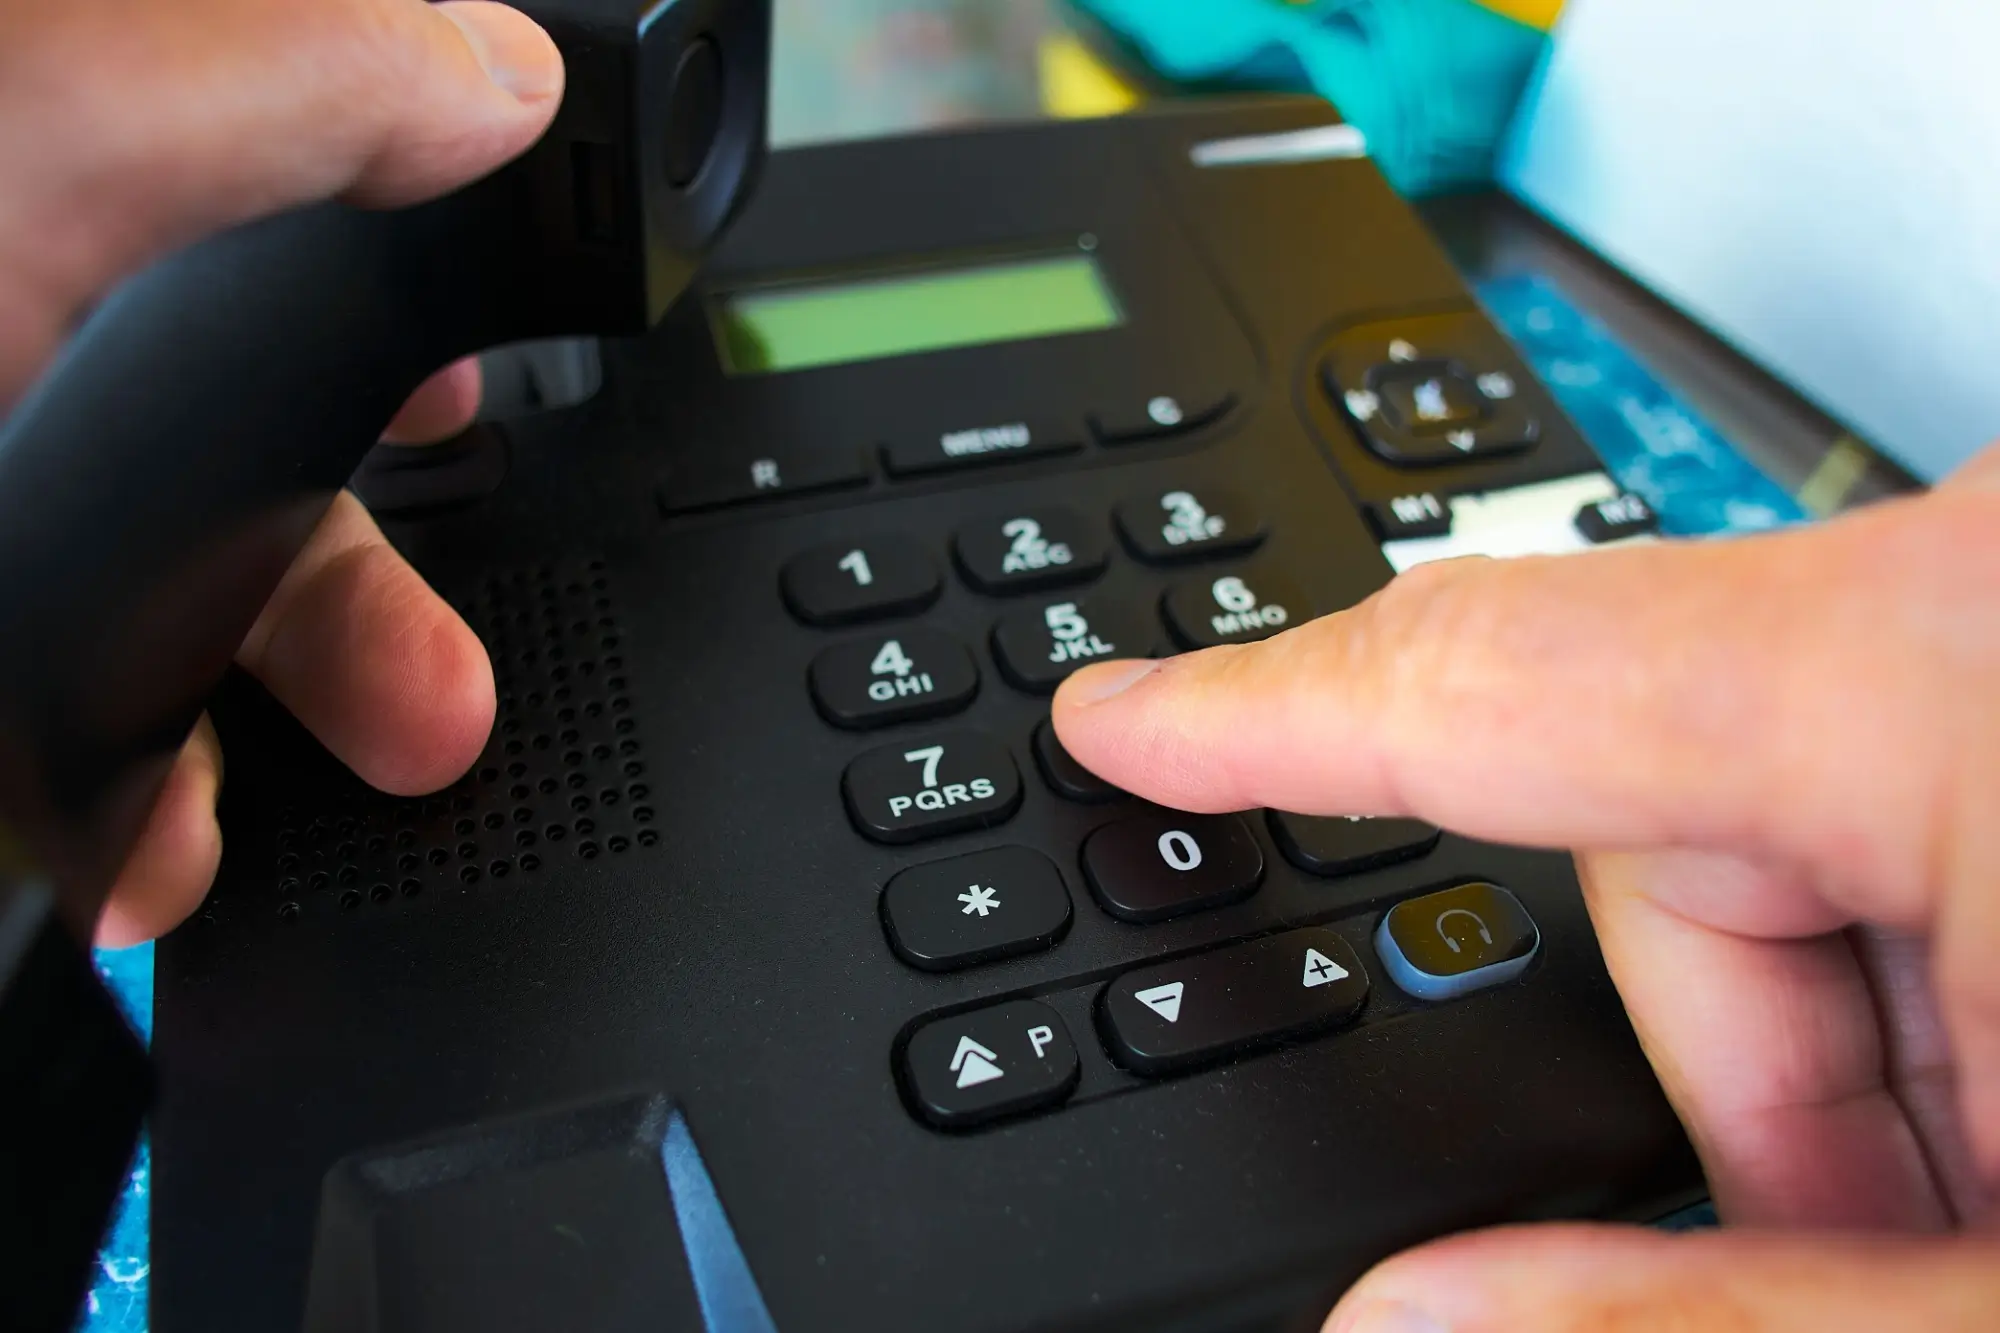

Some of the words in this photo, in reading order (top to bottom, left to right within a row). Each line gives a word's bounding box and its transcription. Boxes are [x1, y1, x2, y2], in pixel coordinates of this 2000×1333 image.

[941, 423, 1030, 456] MENU
[751, 459, 780, 488] R
[1161, 491, 1203, 526] 3
[1003, 518, 1043, 555] 2
[838, 549, 873, 585] 1
[1003, 541, 1074, 573] ABC
[1211, 576, 1257, 612] 6
[1044, 602, 1089, 641] 5
[1211, 604, 1288, 635] MNO
[870, 640, 914, 679] 4
[1048, 634, 1115, 663] JKL
[867, 672, 935, 702] GHI
[902, 745, 945, 788] 7
[887, 776, 996, 818] PQRS
[1156, 829, 1203, 873] 0
[1026, 1024, 1054, 1059] P
